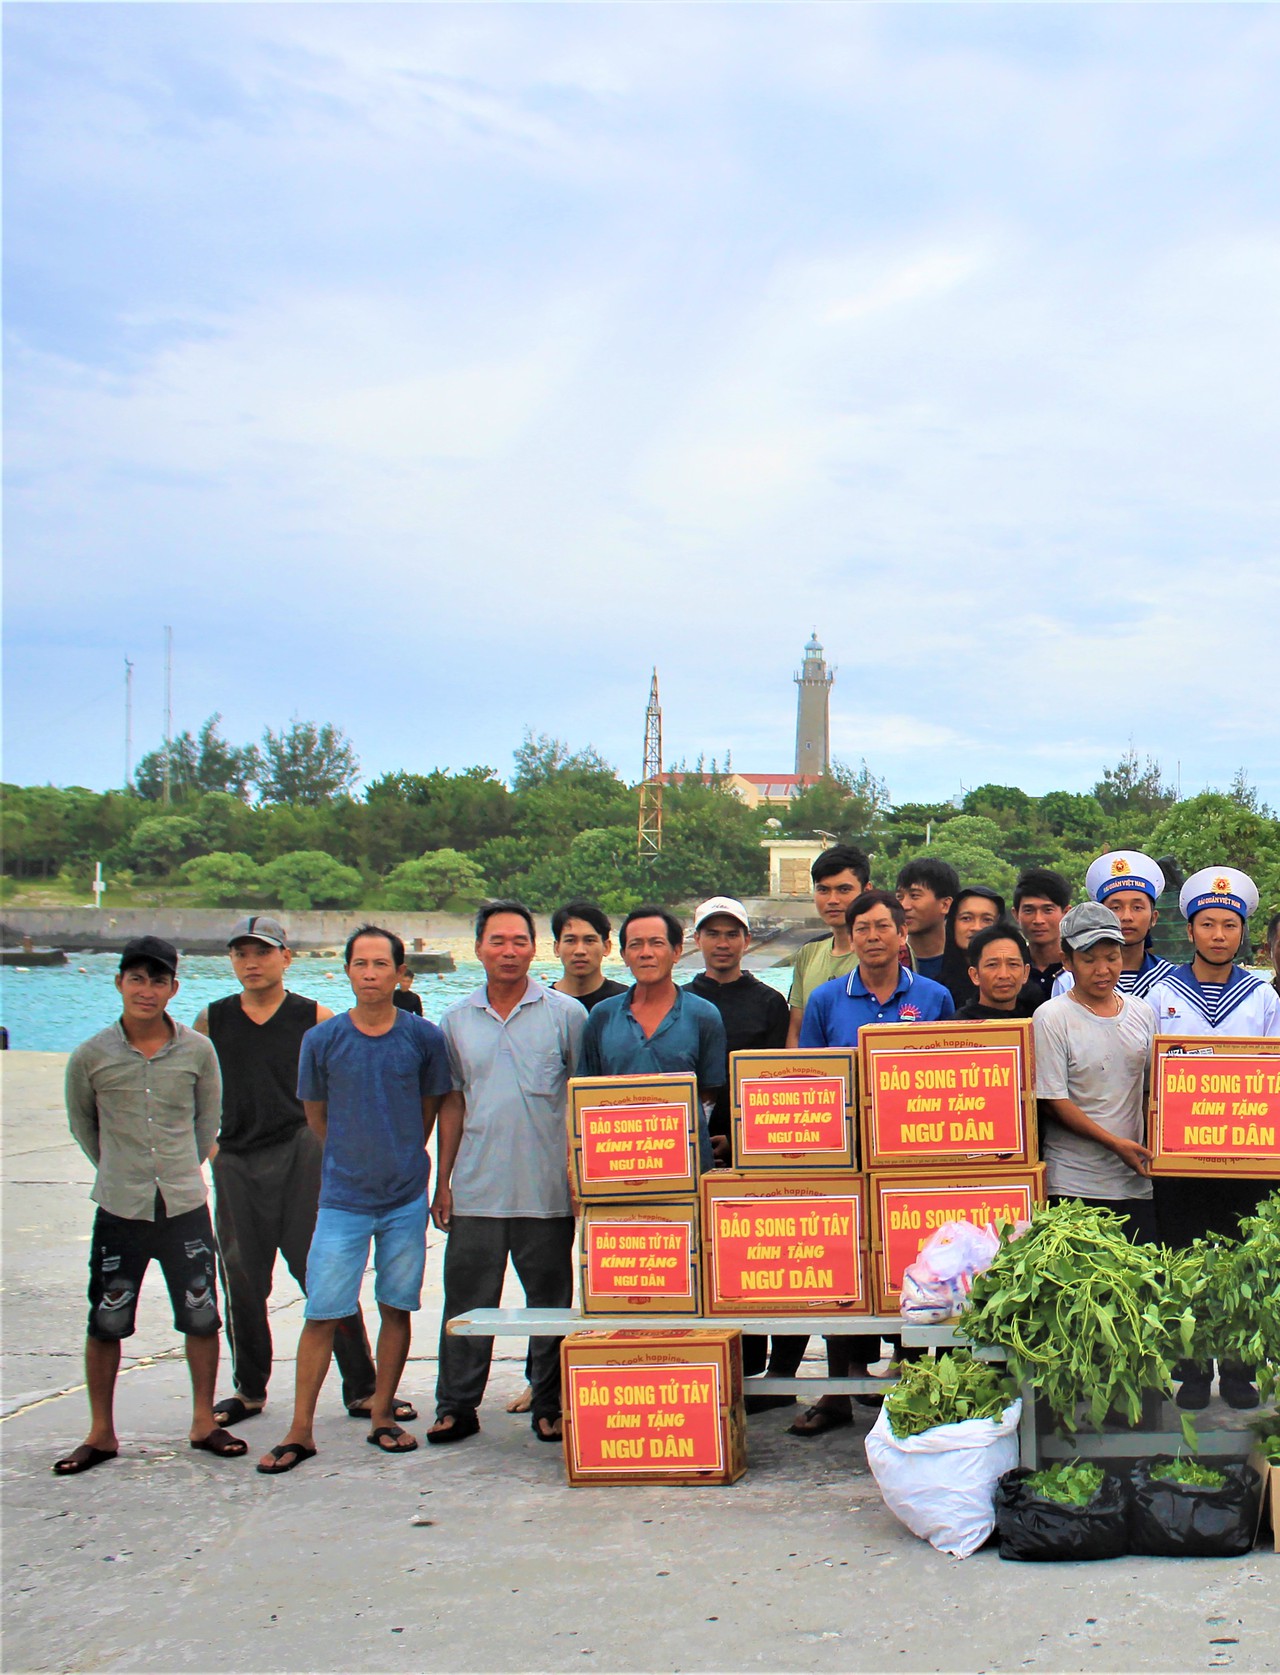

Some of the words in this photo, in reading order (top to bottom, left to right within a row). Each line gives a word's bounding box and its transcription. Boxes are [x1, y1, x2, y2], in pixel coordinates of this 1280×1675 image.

[880, 1065, 910, 1090] ĐẢO
[915, 1069, 956, 1089] SONG
[960, 1063, 980, 1087] TỬ
[983, 1064, 1010, 1087] TÂY
[1167, 1069, 1195, 1093] ĐẢO
[1201, 1075, 1240, 1093] SONG
[1245, 1069, 1264, 1094] TỬ
[749, 1089, 769, 1106] ĐẢO
[772, 1092, 799, 1105] SONG
[802, 1088, 816, 1104] TỬ
[818, 1089, 835, 1104] TÂY
[907, 1095, 941, 1112] KÍNH
[948, 1094, 985, 1115] TẶNG
[755, 1111, 790, 1124] KÍNH
[794, 1110, 832, 1126] TẶNG
[1192, 1098, 1225, 1115] KÍNH
[1232, 1099, 1268, 1119] TẶNG
[590, 1117, 610, 1134] ĐẢO
[614, 1119, 642, 1133] SONG
[645, 1115, 658, 1132] TỬ
[660, 1116, 678, 1130] TÂY
[901, 1122, 945, 1143] NGƯ
[950, 1118, 993, 1141] DÂN
[1184, 1125, 1227, 1145] NGƯ
[1232, 1123, 1274, 1146] DÂN
[596, 1139, 632, 1152] KÍNH
[636, 1137, 675, 1153] TẶNG
[768, 1131, 792, 1143] NGƯ
[795, 1130, 819, 1142] DÂN
[610, 1158, 636, 1170] NGƯ
[638, 1156, 662, 1168] DÂN
[721, 1212, 750, 1238] ĐẢO
[755, 1218, 795, 1237] SONG
[800, 1211, 819, 1236] TỬ
[822, 1213, 849, 1235] TÂY
[890, 1204, 920, 1230] ĐẢO
[970, 1202, 990, 1227] TỬ
[596, 1232, 616, 1249] ĐẢO
[619, 1237, 646, 1249] SONG
[648, 1232, 661, 1249] TỬ
[664, 1234, 681, 1249] TÂY
[601, 1255, 636, 1268] KÍNH
[639, 1255, 677, 1270] TẶNG
[747, 1243, 781, 1259] KÍNH
[788, 1242, 824, 1262] TẶNG
[614, 1275, 638, 1286] NGƯ
[641, 1274, 664, 1286] DÂN
[741, 1269, 785, 1289] NGƯ
[790, 1266, 832, 1288] DÂN
[580, 1380, 609, 1406] ĐẢO
[614, 1386, 655, 1405] SONG
[659, 1379, 678, 1404] TỬ
[682, 1380, 709, 1403] TÂY
[607, 1411, 641, 1428] KÍNH
[648, 1410, 685, 1431] TẶNG
[601, 1438, 645, 1458] NGƯ
[650, 1435, 694, 1457] DÂN
